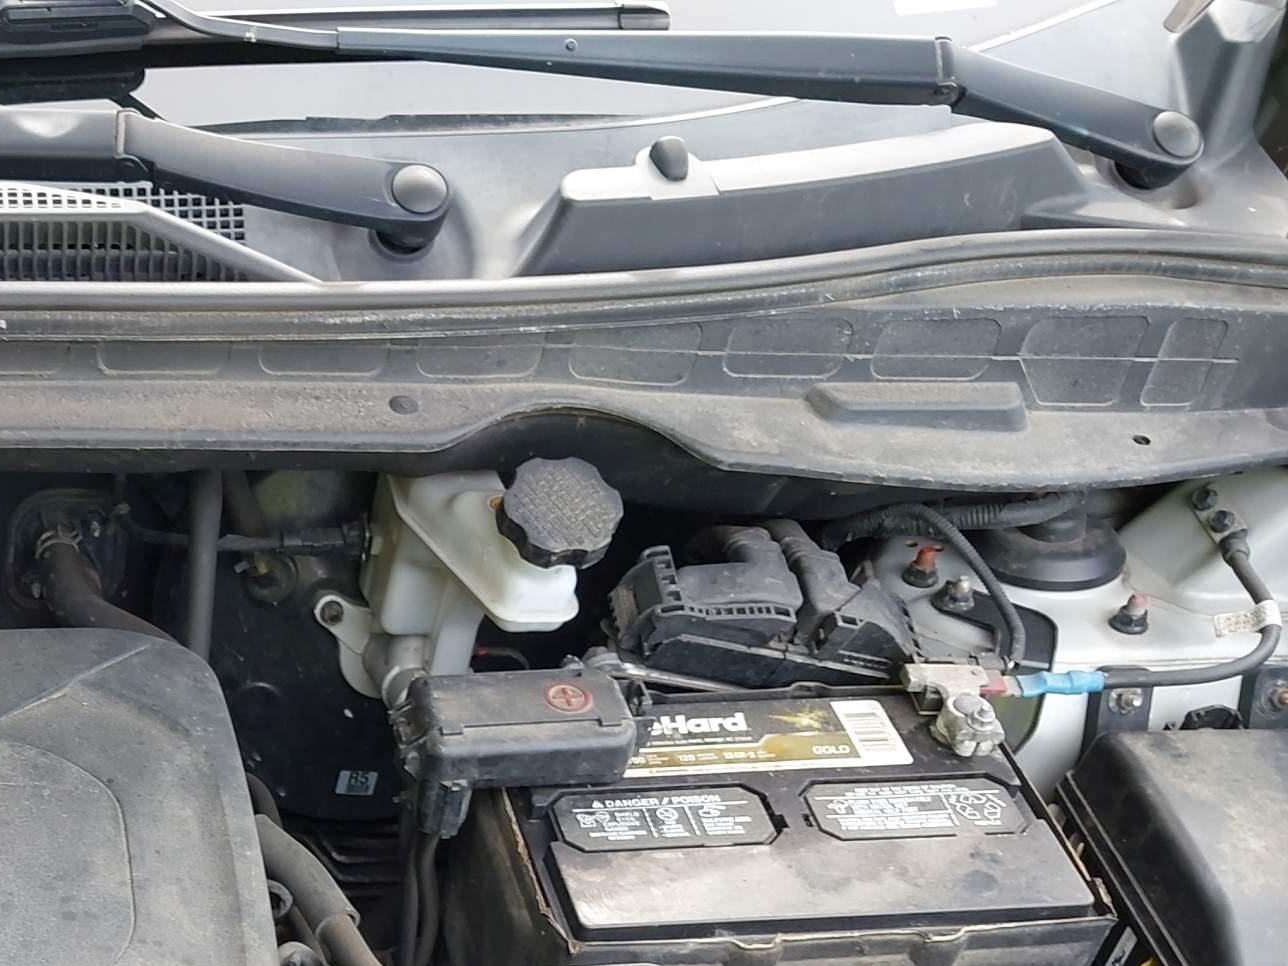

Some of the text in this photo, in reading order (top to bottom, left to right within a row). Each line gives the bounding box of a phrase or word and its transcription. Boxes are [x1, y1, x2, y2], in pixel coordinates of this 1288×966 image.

[812, 745, 850, 755] GOLD
[605, 798, 659, 808] DANGER
[672, 795, 721, 805] POISON
